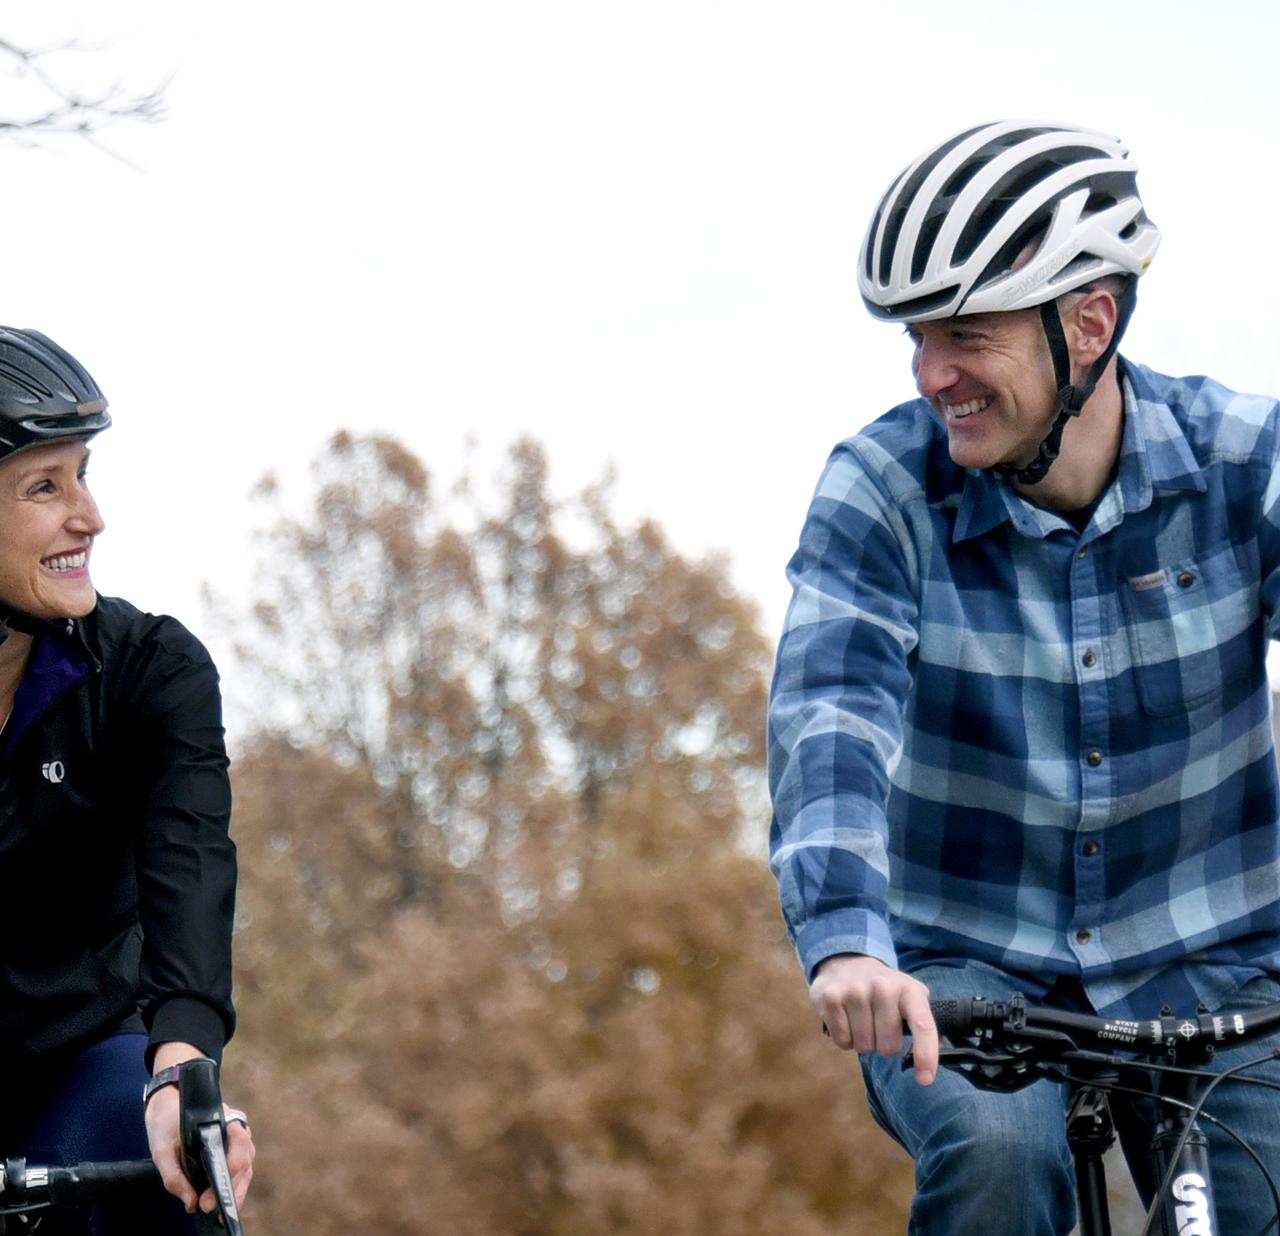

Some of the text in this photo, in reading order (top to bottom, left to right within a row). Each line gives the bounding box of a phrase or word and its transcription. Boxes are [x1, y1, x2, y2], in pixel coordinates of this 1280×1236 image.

[1104, 1024, 1138, 1035] BICYCLE
[1115, 1020, 1139, 1028] STATE
[1097, 1030, 1136, 1043] COMPANY
